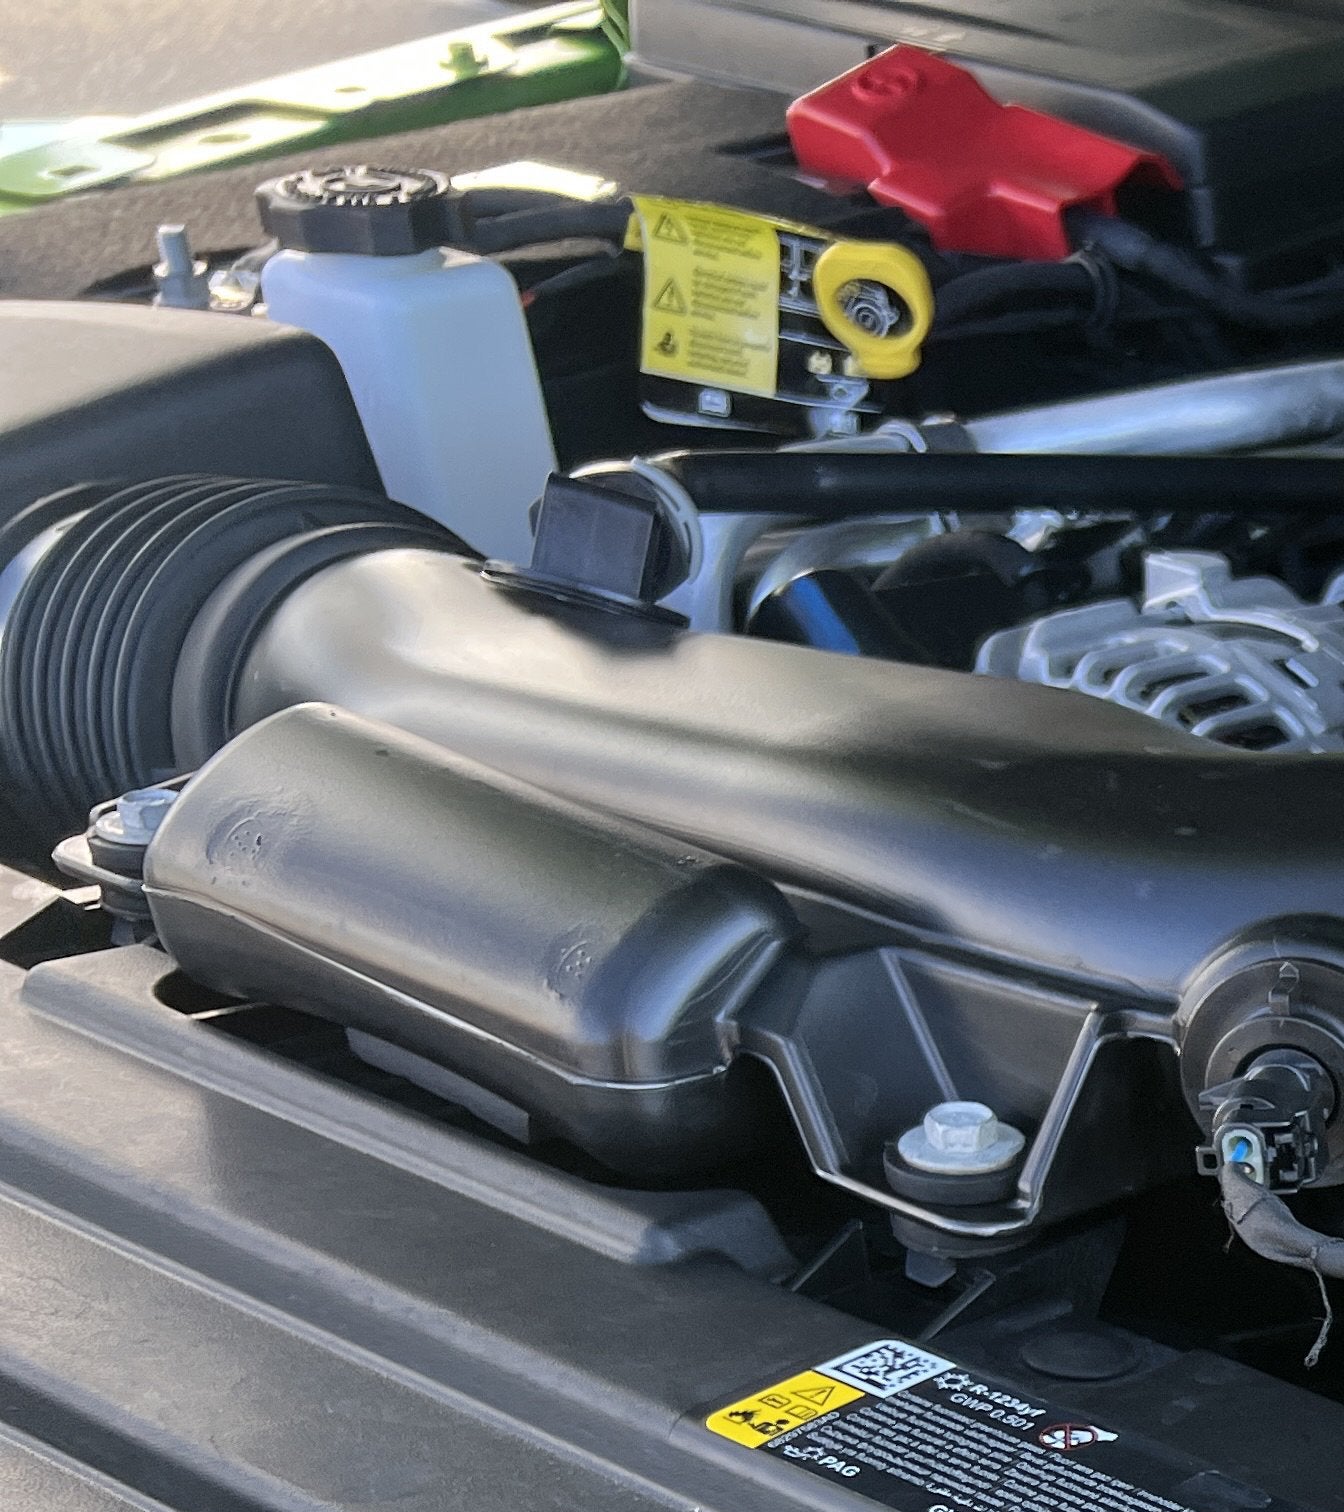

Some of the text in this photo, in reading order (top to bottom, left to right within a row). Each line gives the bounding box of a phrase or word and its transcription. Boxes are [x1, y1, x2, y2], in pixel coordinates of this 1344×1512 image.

[949, 1393, 993, 1411] GWP
[987, 1409, 1034, 1430] 0.501
[968, 1383, 1046, 1417] R-1234yf
[817, 1455, 860, 1476] PAG
